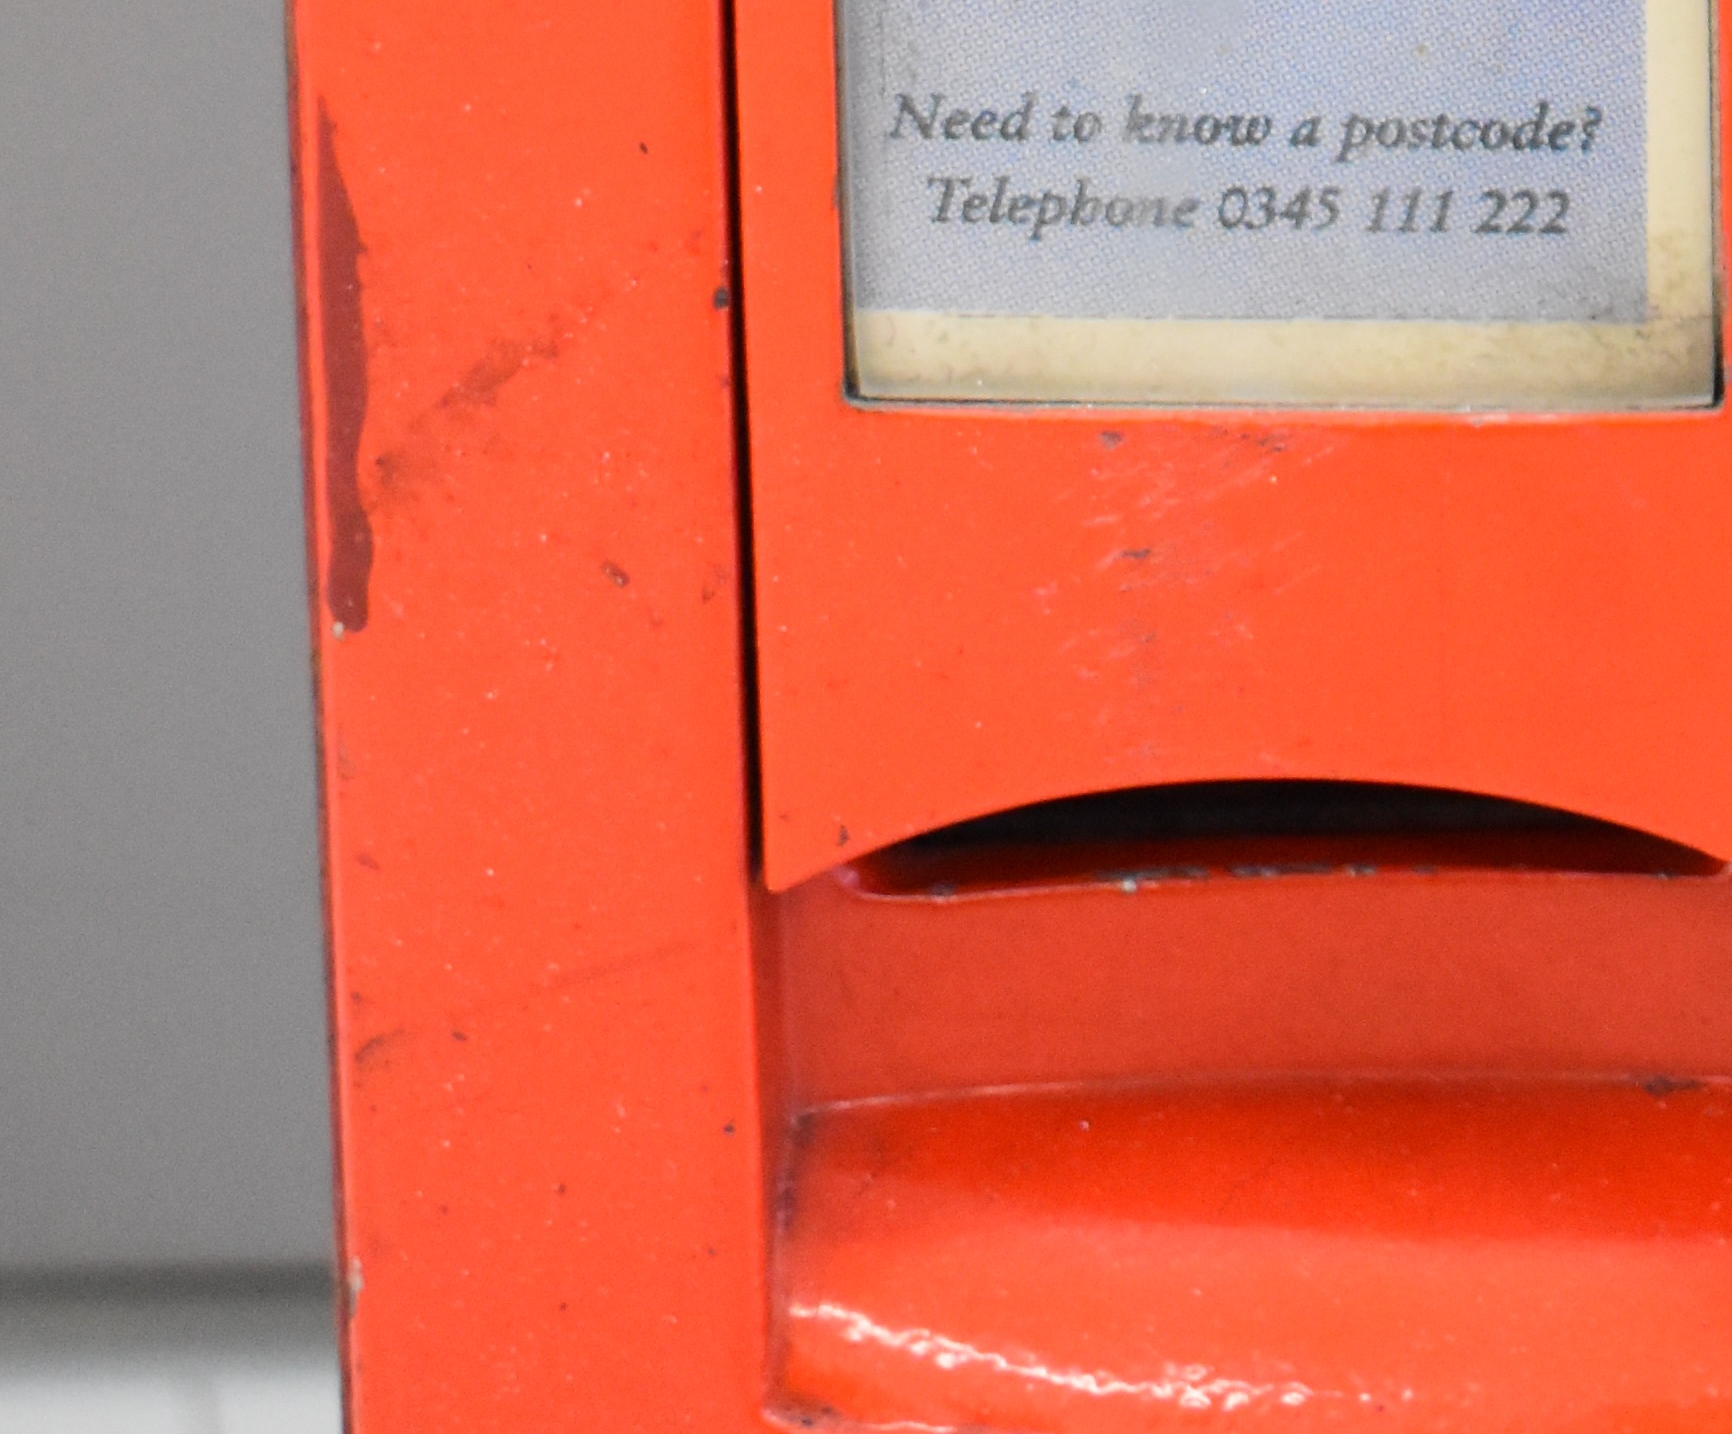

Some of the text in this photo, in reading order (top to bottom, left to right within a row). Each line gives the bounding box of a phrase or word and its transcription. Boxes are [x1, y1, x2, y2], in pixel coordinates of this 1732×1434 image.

[889, 93, 1600, 162] Need to know a postcode?
[926, 175, 1571, 240] Telephone 0345 111 222
